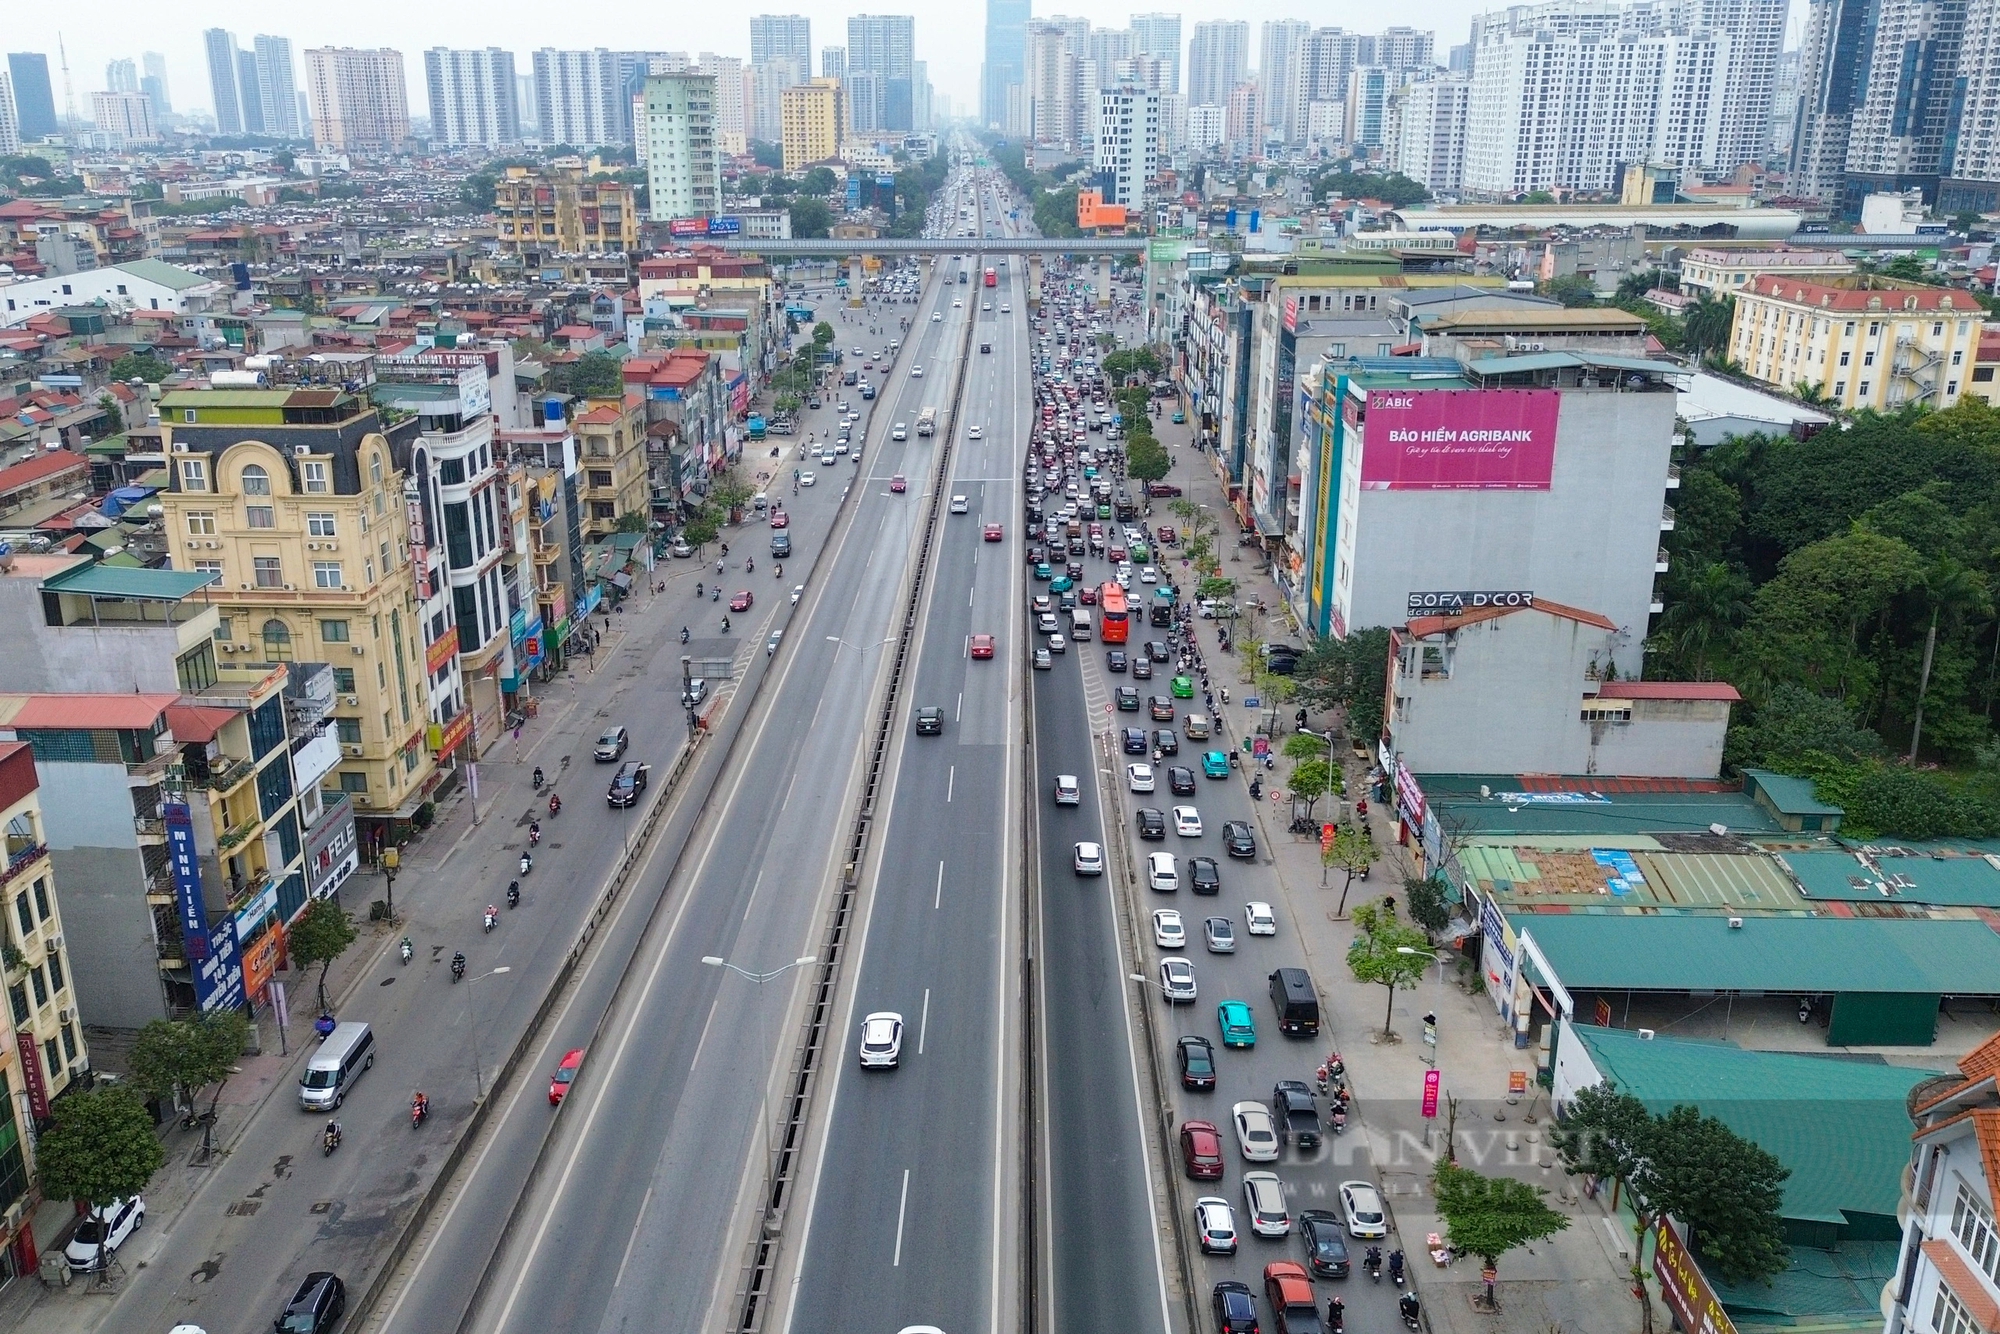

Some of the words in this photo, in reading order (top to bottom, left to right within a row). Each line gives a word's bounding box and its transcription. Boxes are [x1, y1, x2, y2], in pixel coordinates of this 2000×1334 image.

[1385, 397, 1413, 407] ABIC
[1389, 427, 1418, 442] BẢO
[1421, 426, 1457, 442] HIỂM
[1459, 430, 1532, 442] AGRIBANK
[408, 504, 431, 599] HOTEL
[1409, 594, 1463, 606] SOFA
[1473, 593, 1532, 606] D'COR
[1408, 608, 1437, 616] dcor
[174, 831, 191, 876] MINH
[184, 884, 199, 929] TIẾN
[25, 1051, 42, 1111] AGRIBANK
